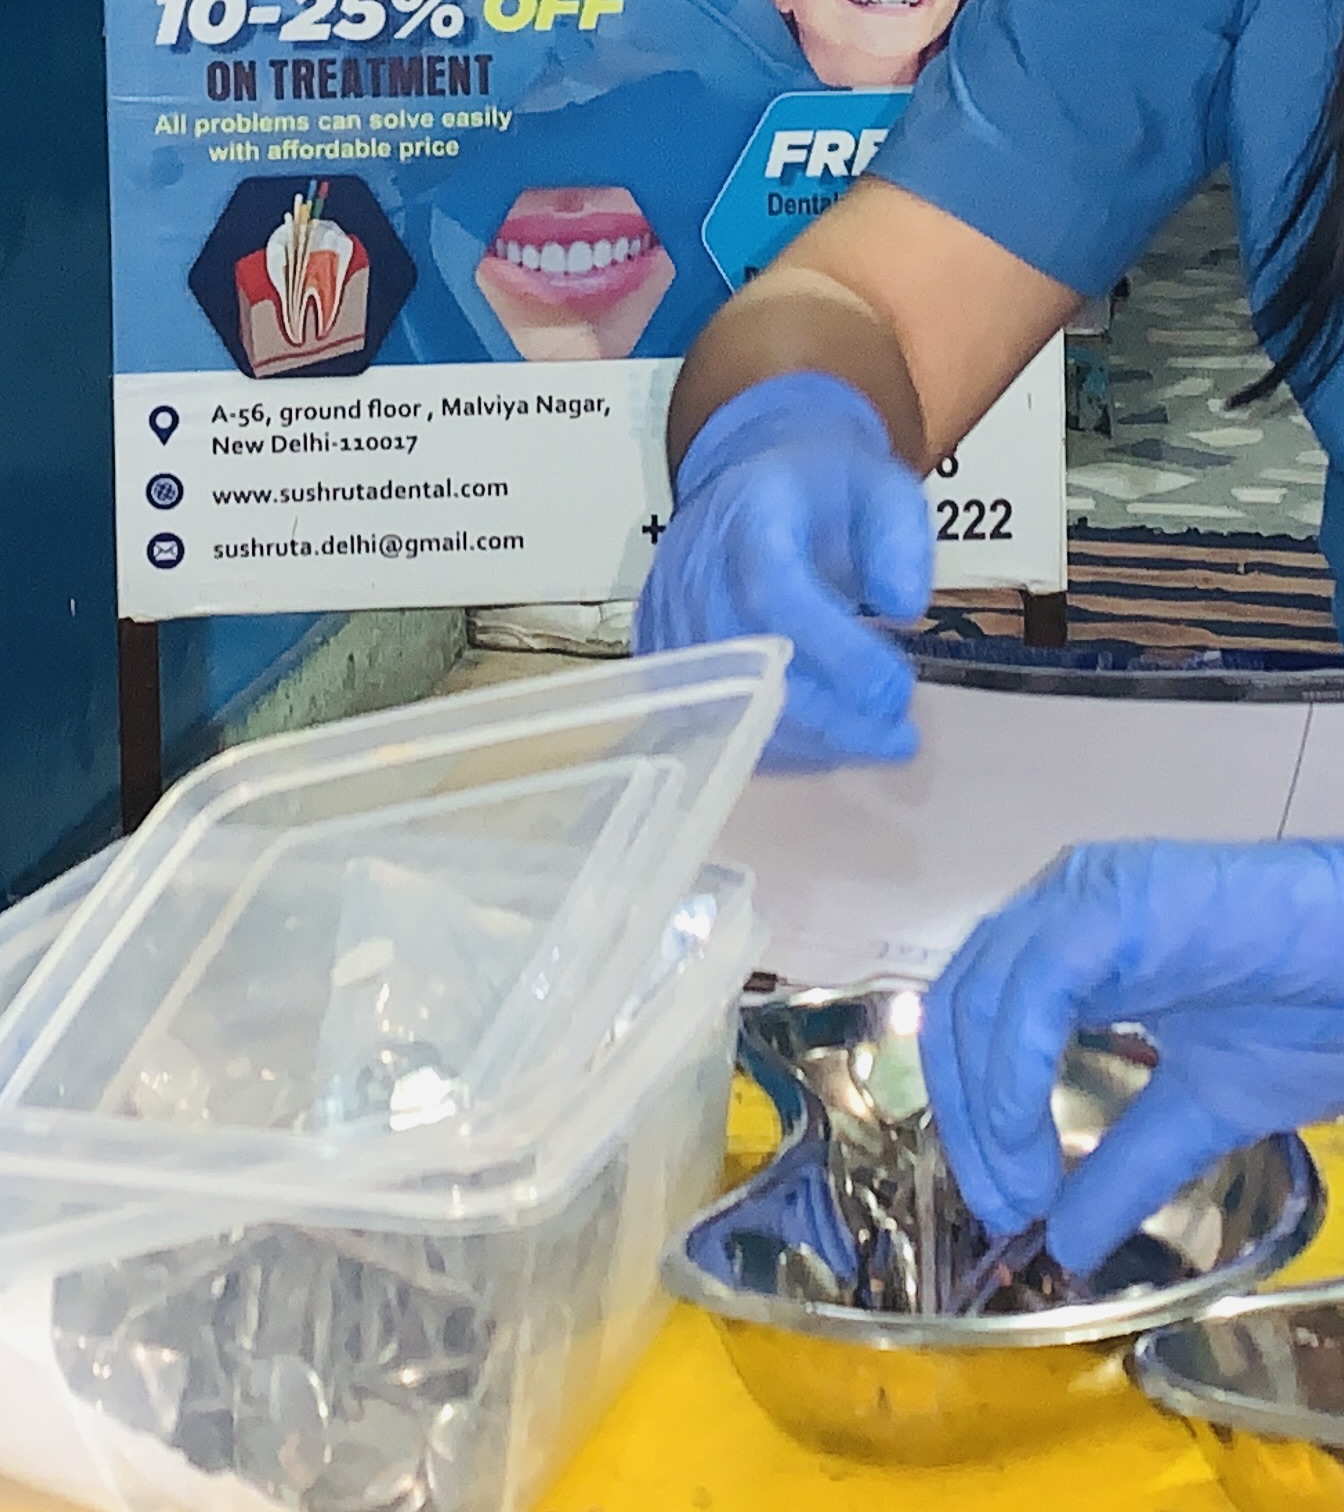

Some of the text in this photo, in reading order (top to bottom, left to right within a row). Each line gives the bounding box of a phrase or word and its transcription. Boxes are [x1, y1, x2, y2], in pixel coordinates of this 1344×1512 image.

[205, 53, 494, 103] ON TREATMENT
[154, 105, 514, 139] All problems can solve easily
[208, 136, 460, 163] with affordable price
[211, 402, 272, 429] A-56,
[279, 398, 362, 427] ground
[367, 397, 422, 421] floor
[441, 393, 531, 422] Malviya
[535, 392, 612, 421] Nagar,
[211, 430, 419, 457] New Delhi-110017
[212, 476, 510, 506] www.sushrutadental.com
[212, 530, 526, 562] sushruta.delhi@gmail.com
